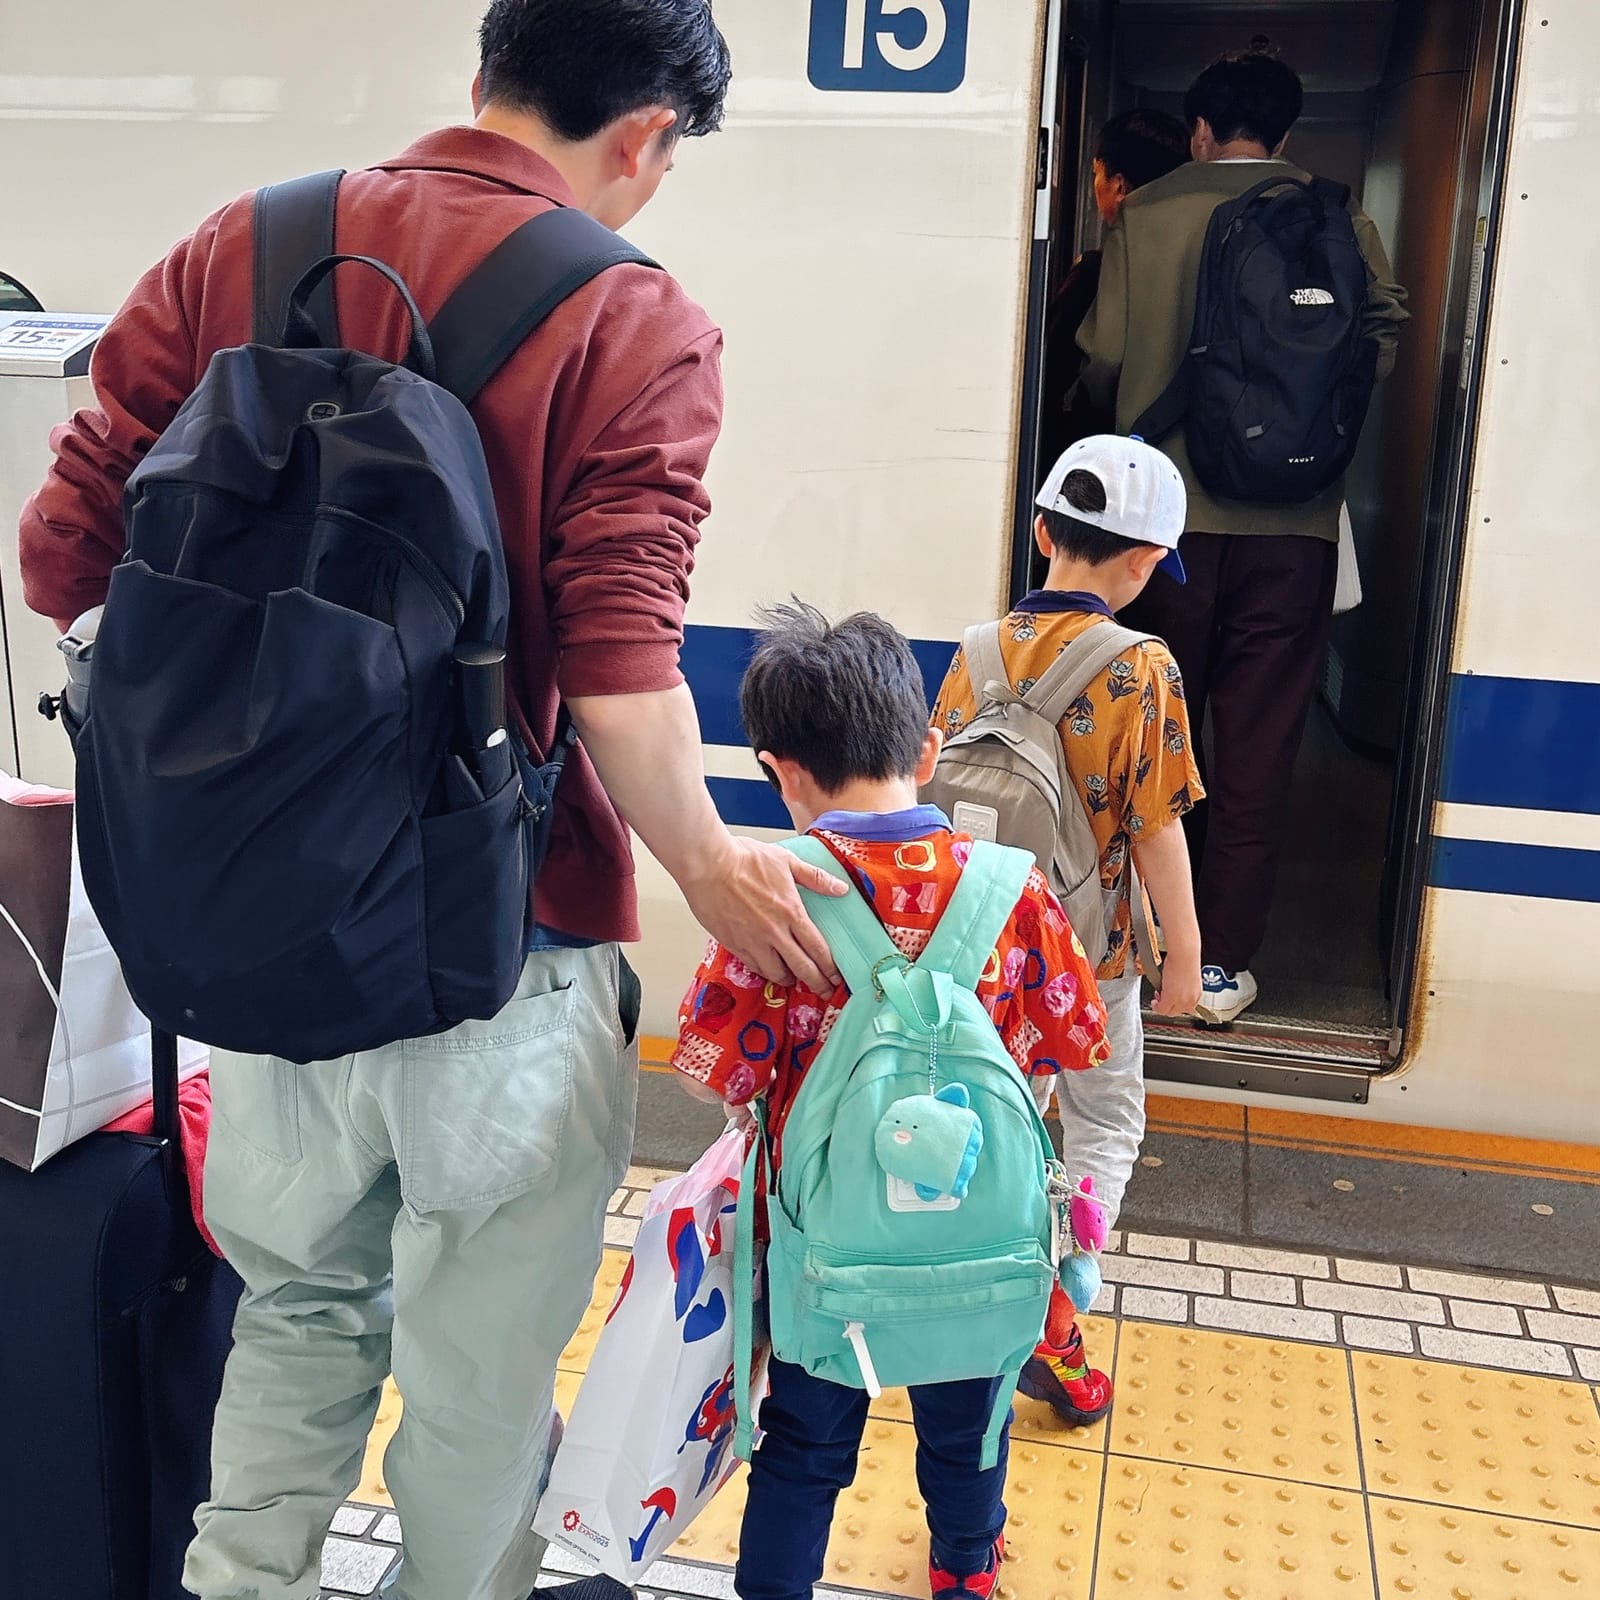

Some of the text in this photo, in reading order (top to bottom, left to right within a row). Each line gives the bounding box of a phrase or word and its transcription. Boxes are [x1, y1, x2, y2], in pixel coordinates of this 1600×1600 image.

[842, 0, 947, 71] 15
[8, 330, 52, 343] 15
[577, 1526, 609, 1548] EXPO2025
